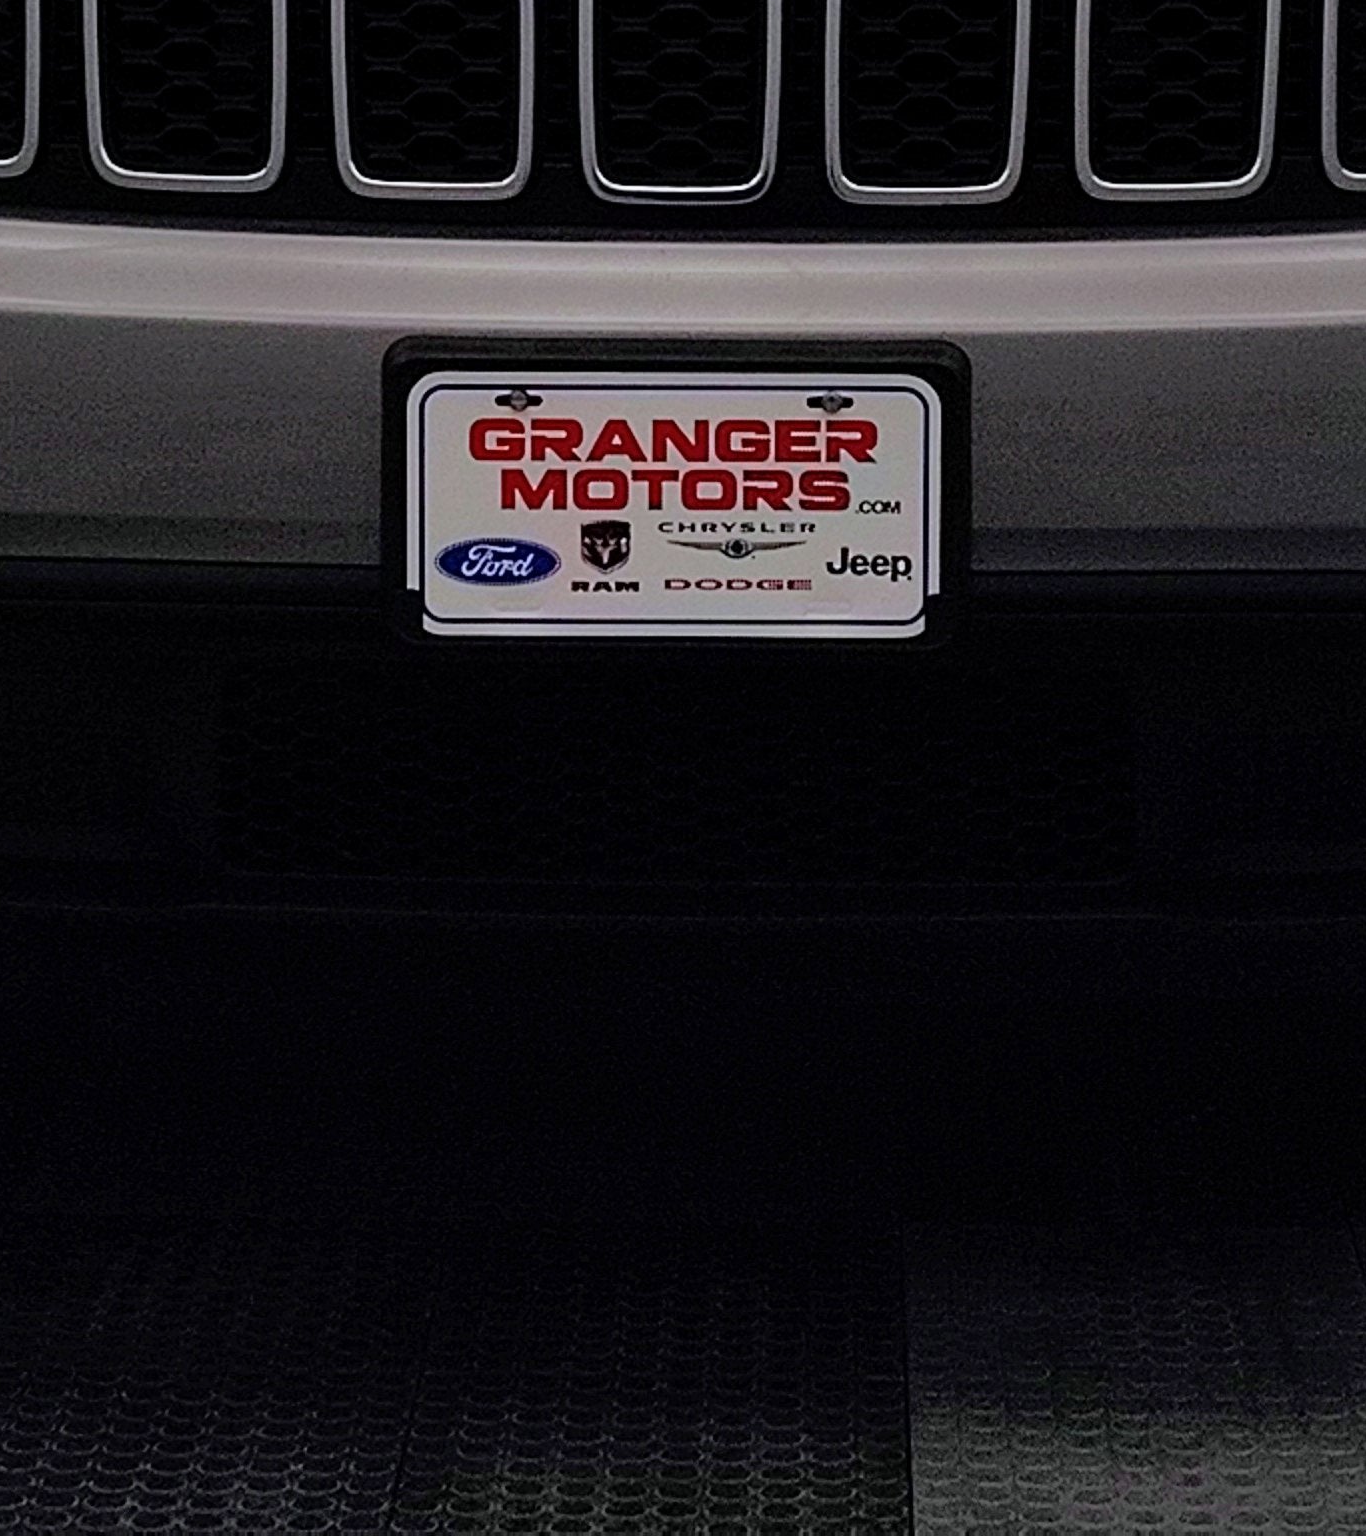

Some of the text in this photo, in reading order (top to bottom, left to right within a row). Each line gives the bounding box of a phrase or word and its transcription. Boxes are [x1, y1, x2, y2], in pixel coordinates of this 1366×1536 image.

[468, 417, 878, 463] GRANGER
[501, 469, 850, 511] MOTORS
[658, 521, 816, 533] CHRYSLER
[461, 544, 534, 576] Ford
[826, 547, 912, 582] Jeep
[571, 581, 639, 592] RAM
[664, 579, 812, 591] DODGE
